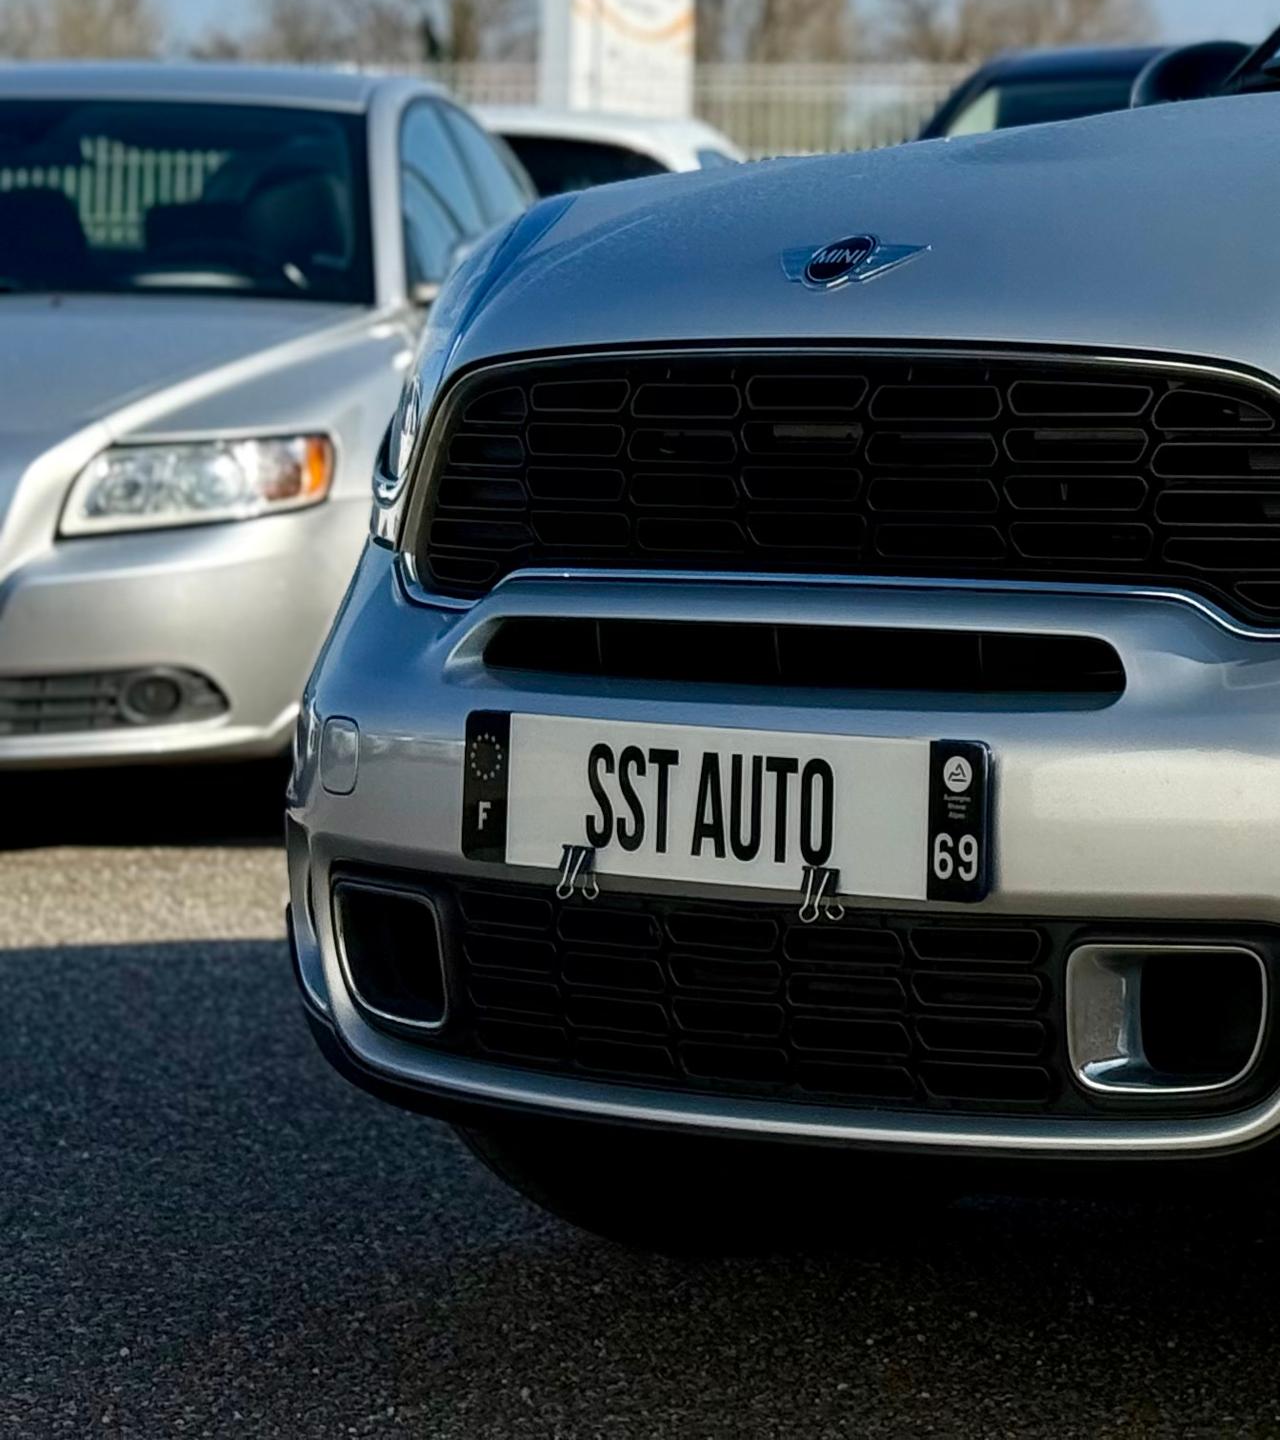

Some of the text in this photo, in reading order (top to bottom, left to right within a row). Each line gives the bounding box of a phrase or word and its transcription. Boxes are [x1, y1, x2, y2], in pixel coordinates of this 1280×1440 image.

[813, 249, 866, 264] MINI
[478, 800, 492, 831] F
[585, 743, 834, 866] SST AUTO
[933, 832, 979, 882] 69
